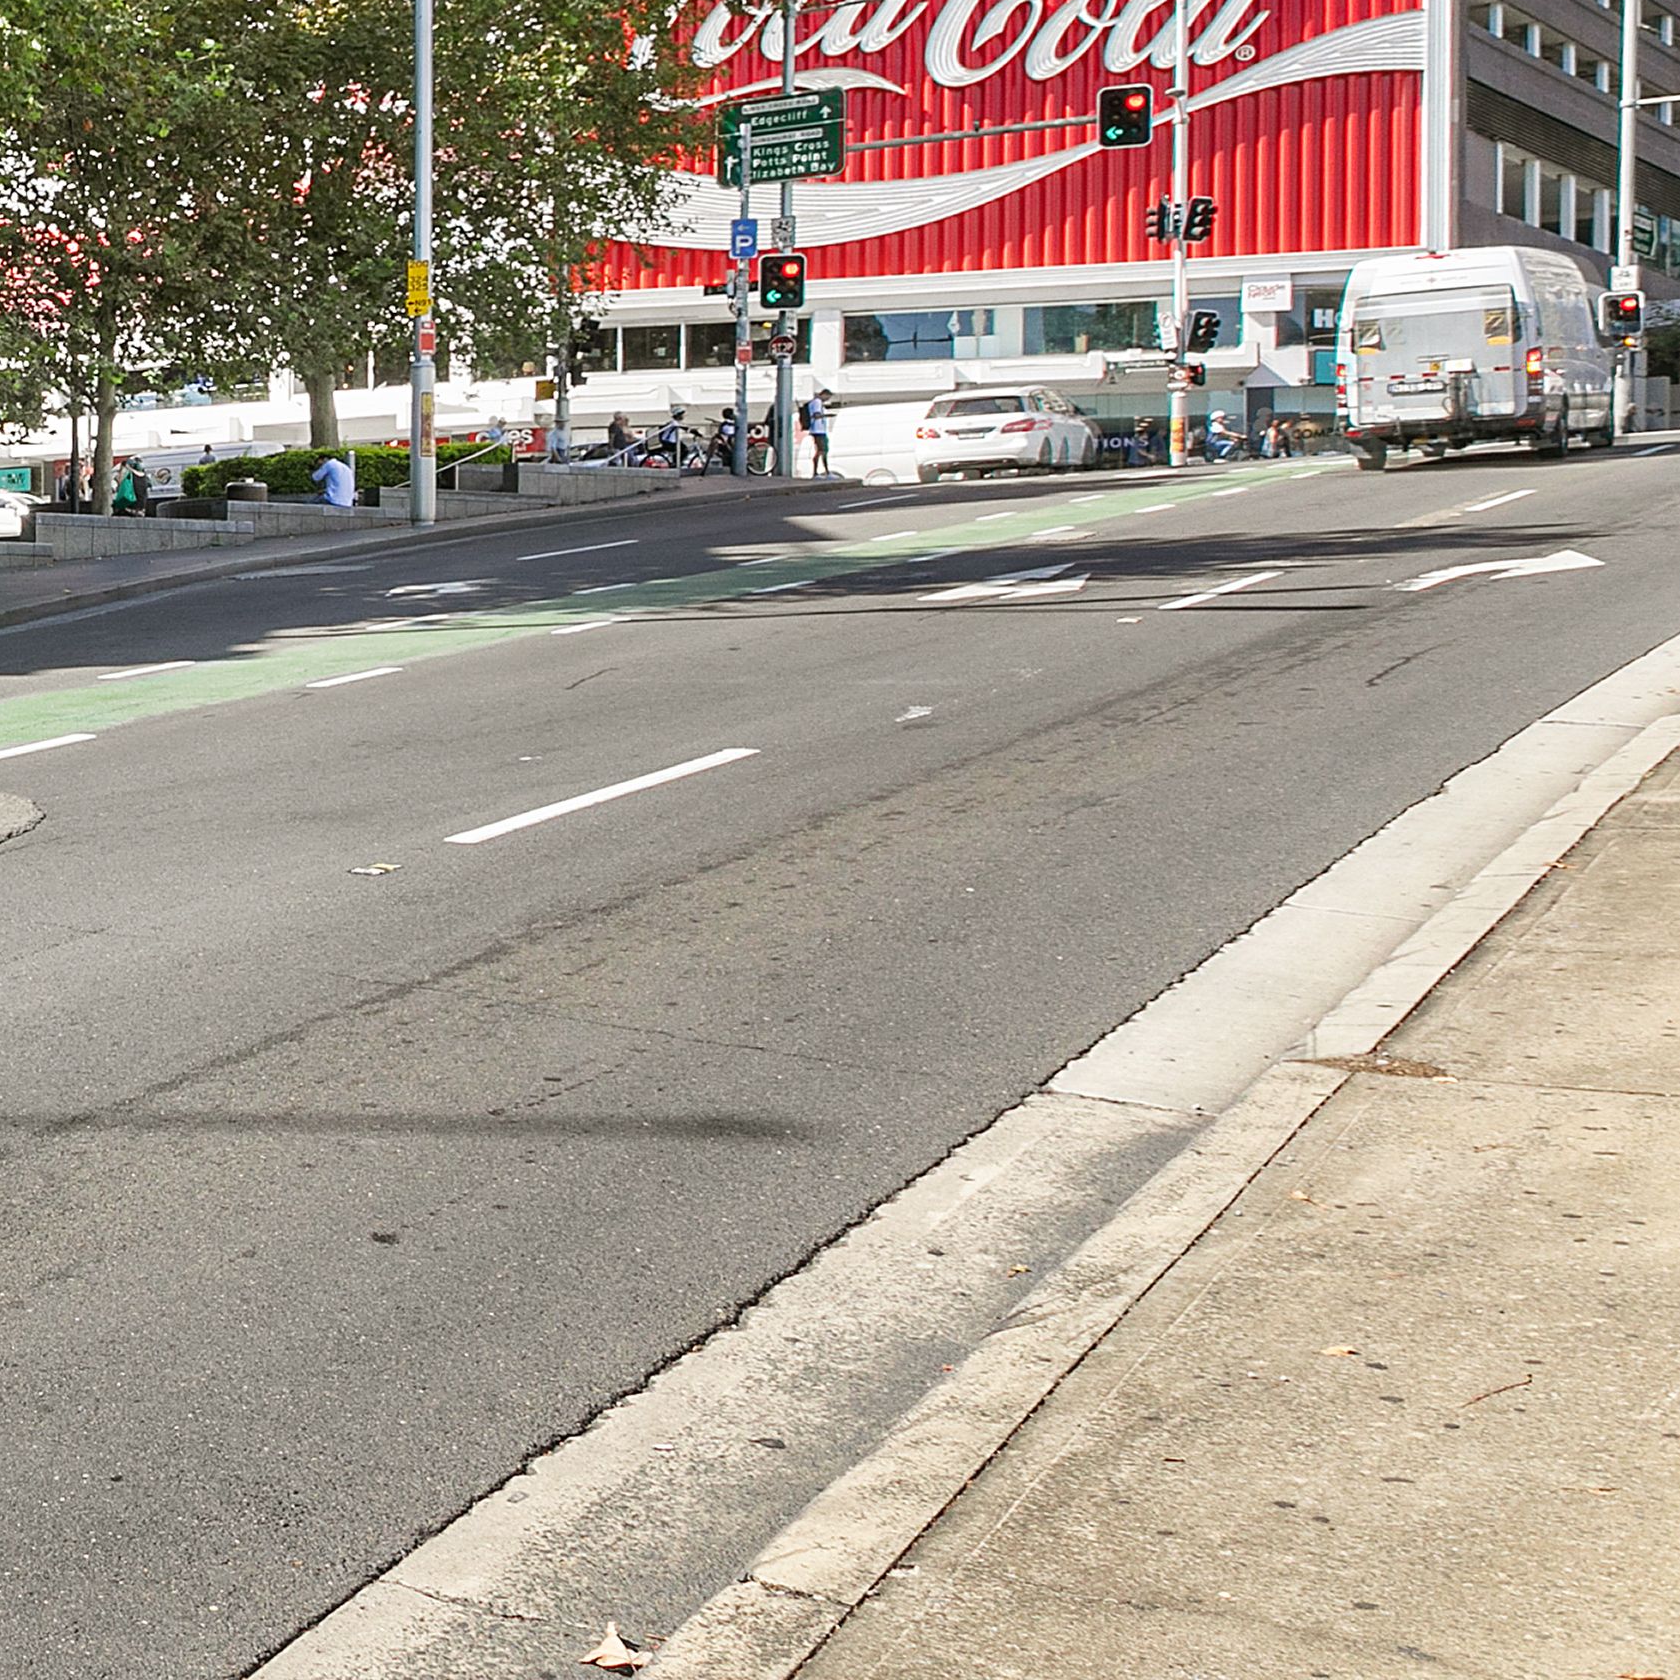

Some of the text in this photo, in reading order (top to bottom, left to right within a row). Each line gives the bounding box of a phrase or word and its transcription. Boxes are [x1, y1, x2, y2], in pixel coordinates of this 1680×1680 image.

[751, 110, 808, 126] Edgecliff
[753, 140, 830, 157] Kings Cross
[753, 151, 827, 168] Potts Point
[810, 162, 836, 173] Bay
[735, 235, 753, 254] P
